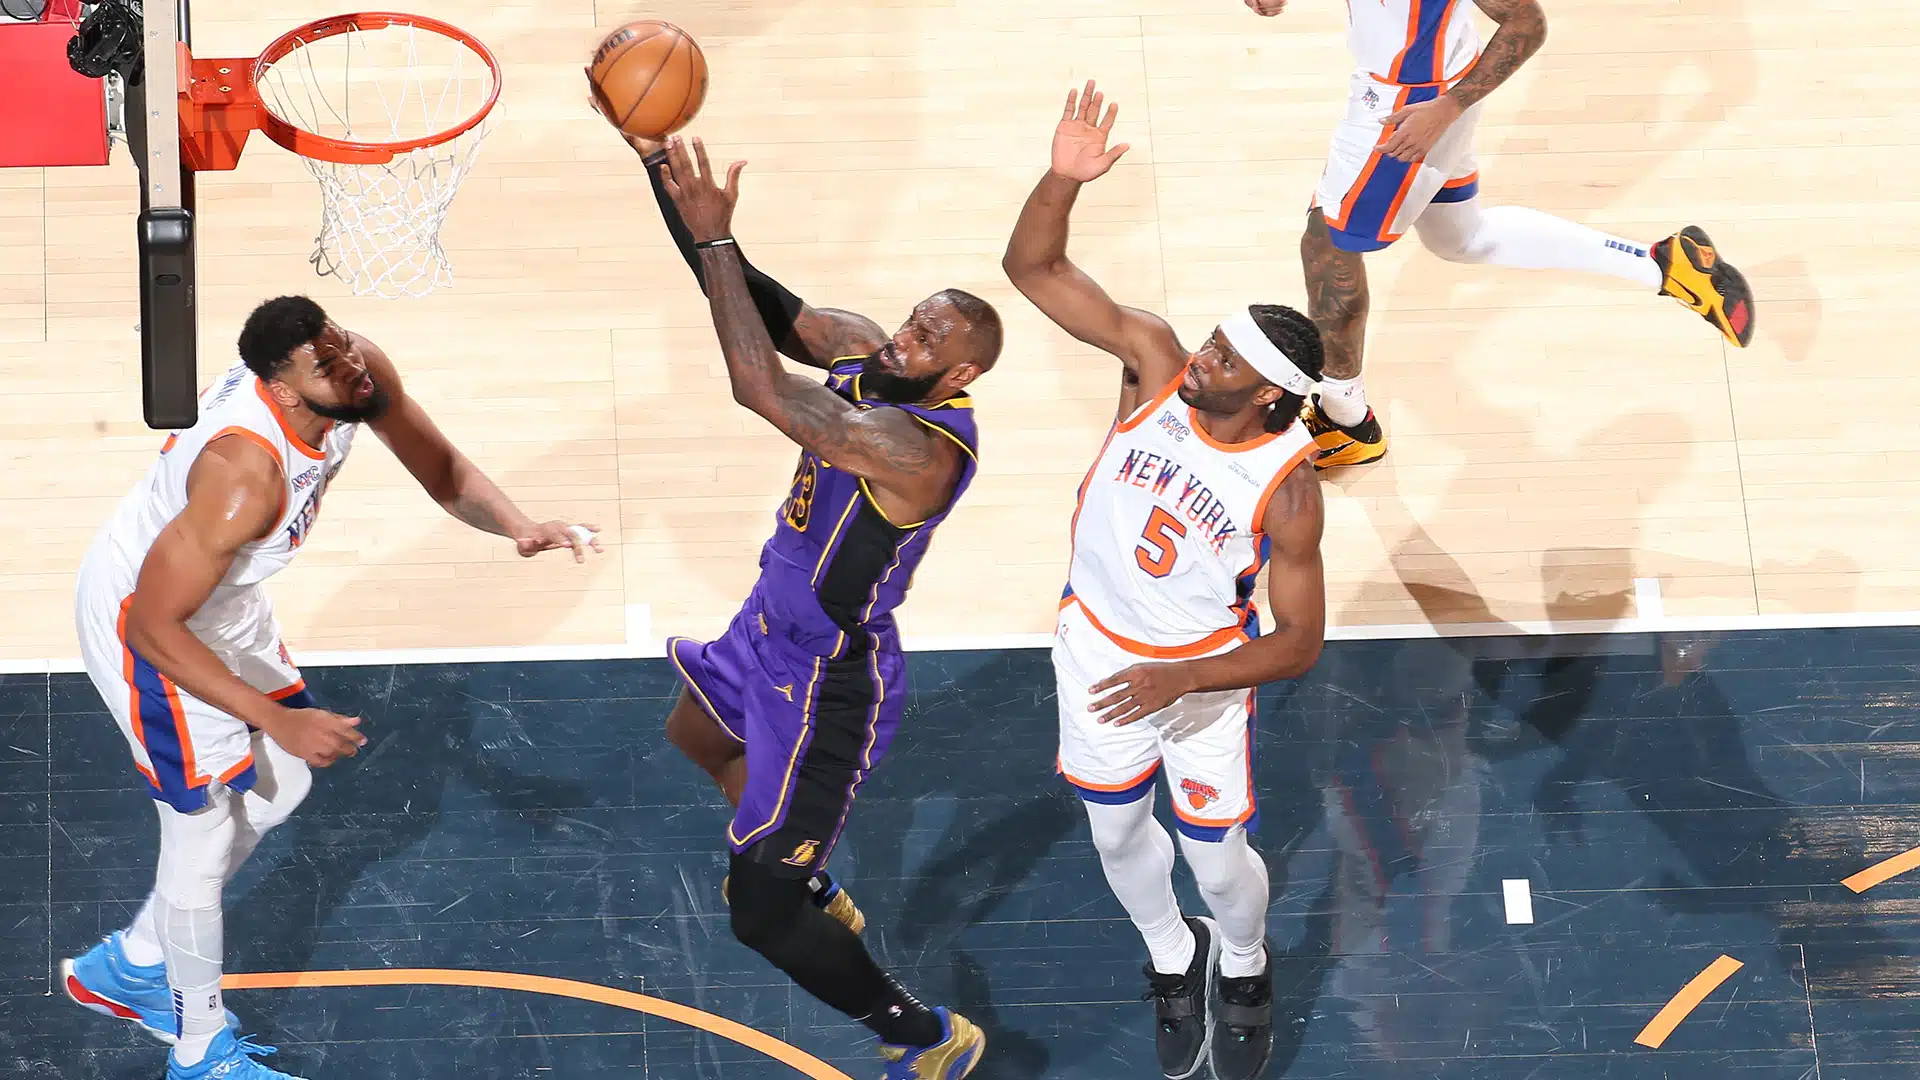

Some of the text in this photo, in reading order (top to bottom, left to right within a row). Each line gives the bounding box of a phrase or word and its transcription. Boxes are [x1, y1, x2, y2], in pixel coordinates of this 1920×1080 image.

[1157, 410, 1190, 442] NYC
[292, 465, 320, 493] NYC
[1114, 449, 1237, 557] NEW YORK
[1134, 504, 1188, 579] 5
[1180, 777, 1220, 800] KNICKS
